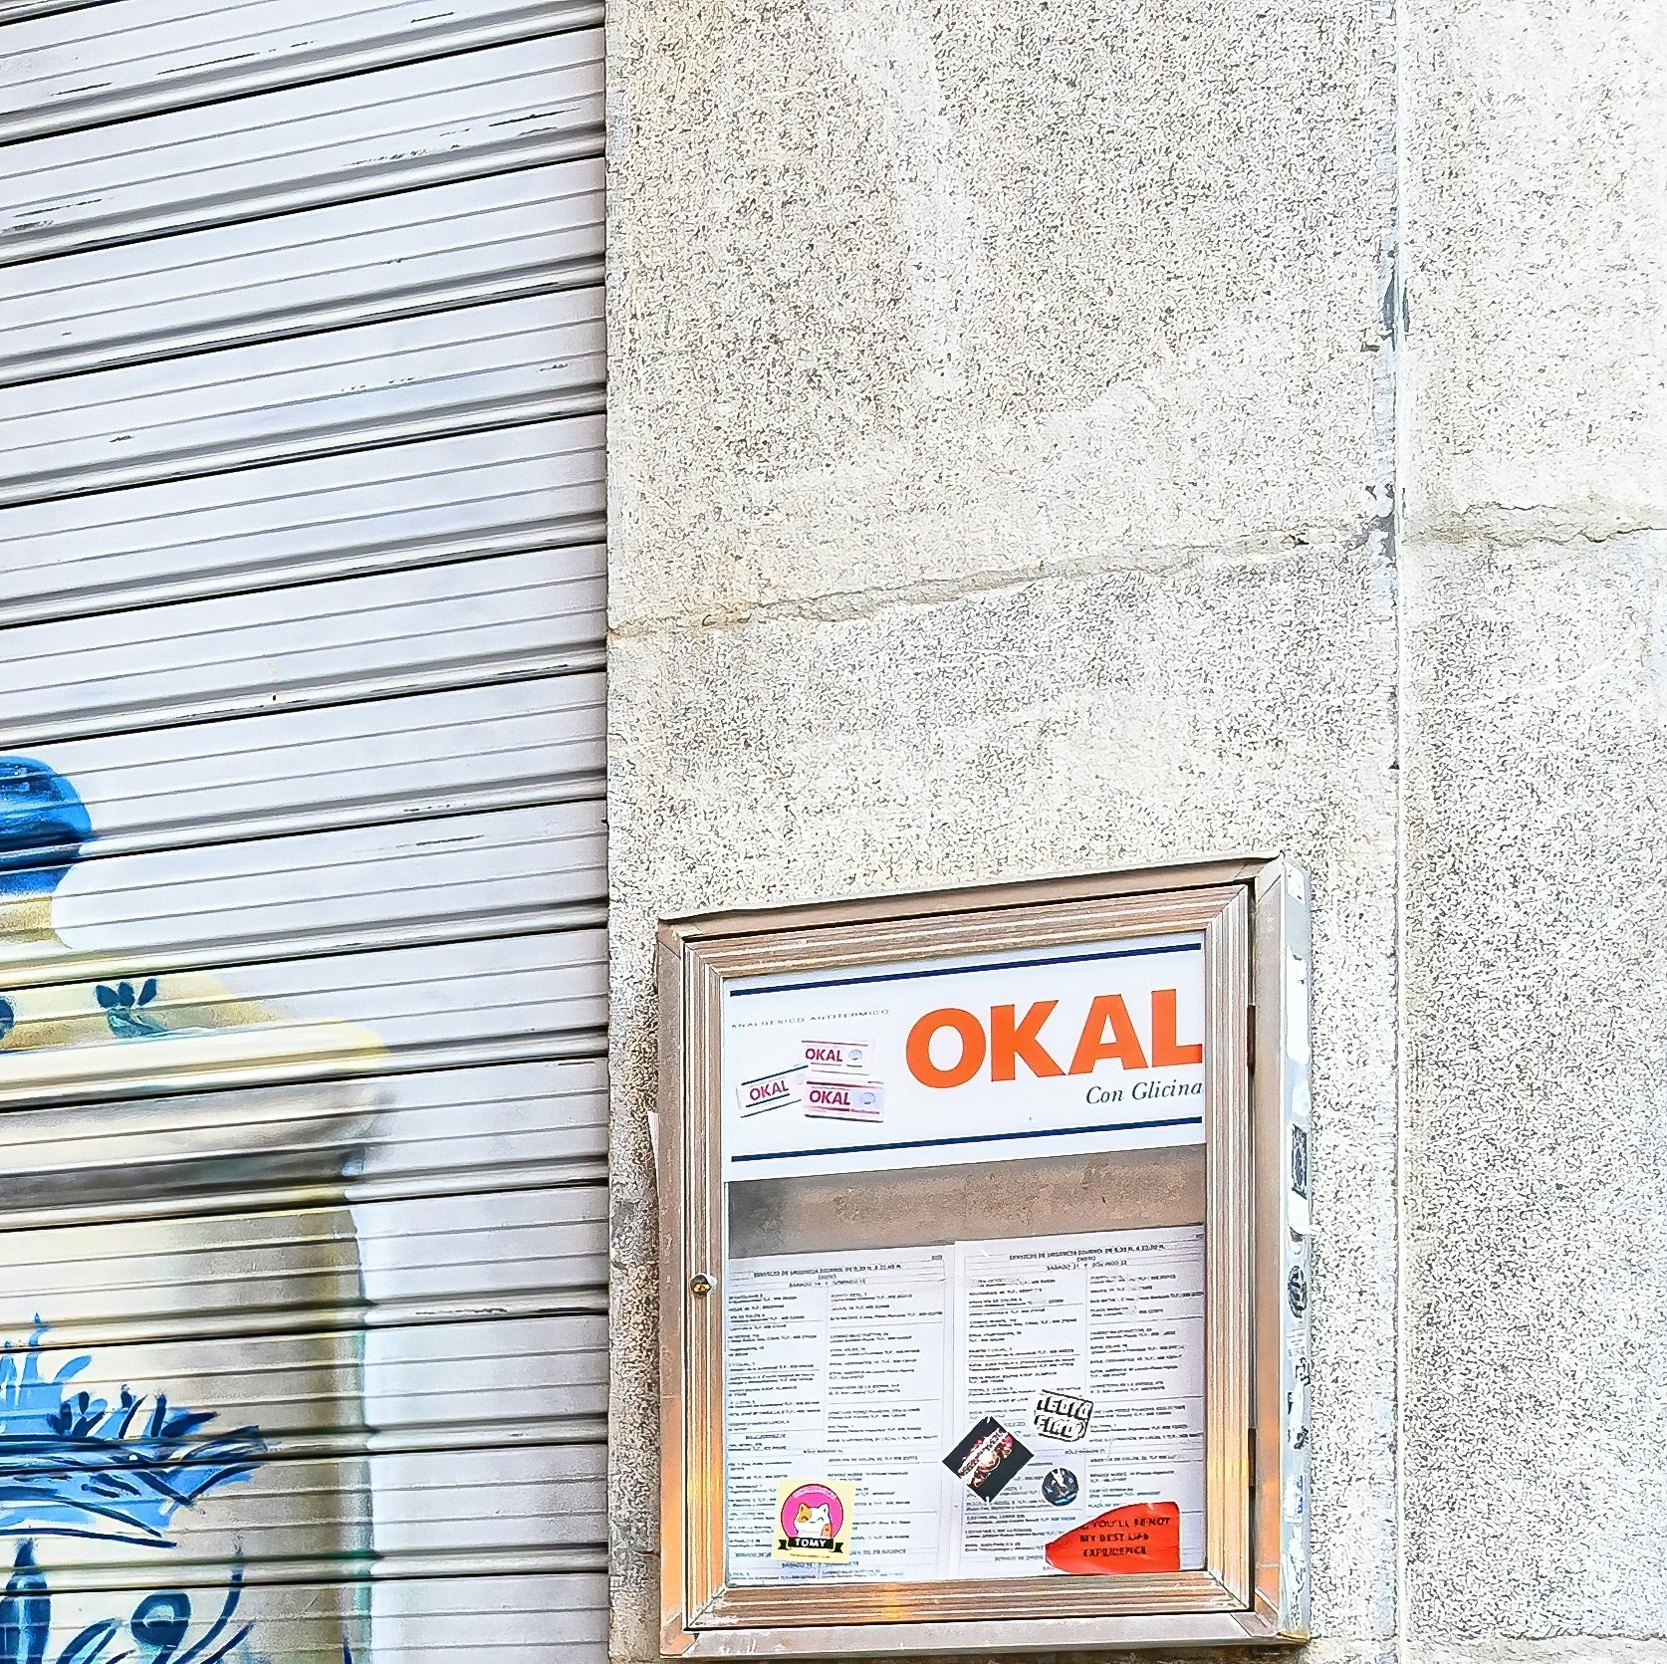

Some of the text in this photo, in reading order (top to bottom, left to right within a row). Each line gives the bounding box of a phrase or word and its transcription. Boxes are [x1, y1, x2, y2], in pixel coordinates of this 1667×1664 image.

[905, 989, 1203, 1090] OKAL
[805, 1047, 844, 1063] OKAL
[749, 1079, 790, 1102] OKAL
[809, 1089, 851, 1106] OKAL
[1086, 1078, 1203, 1105] Con Glicina
[794, 1538, 827, 1548] TOMY
